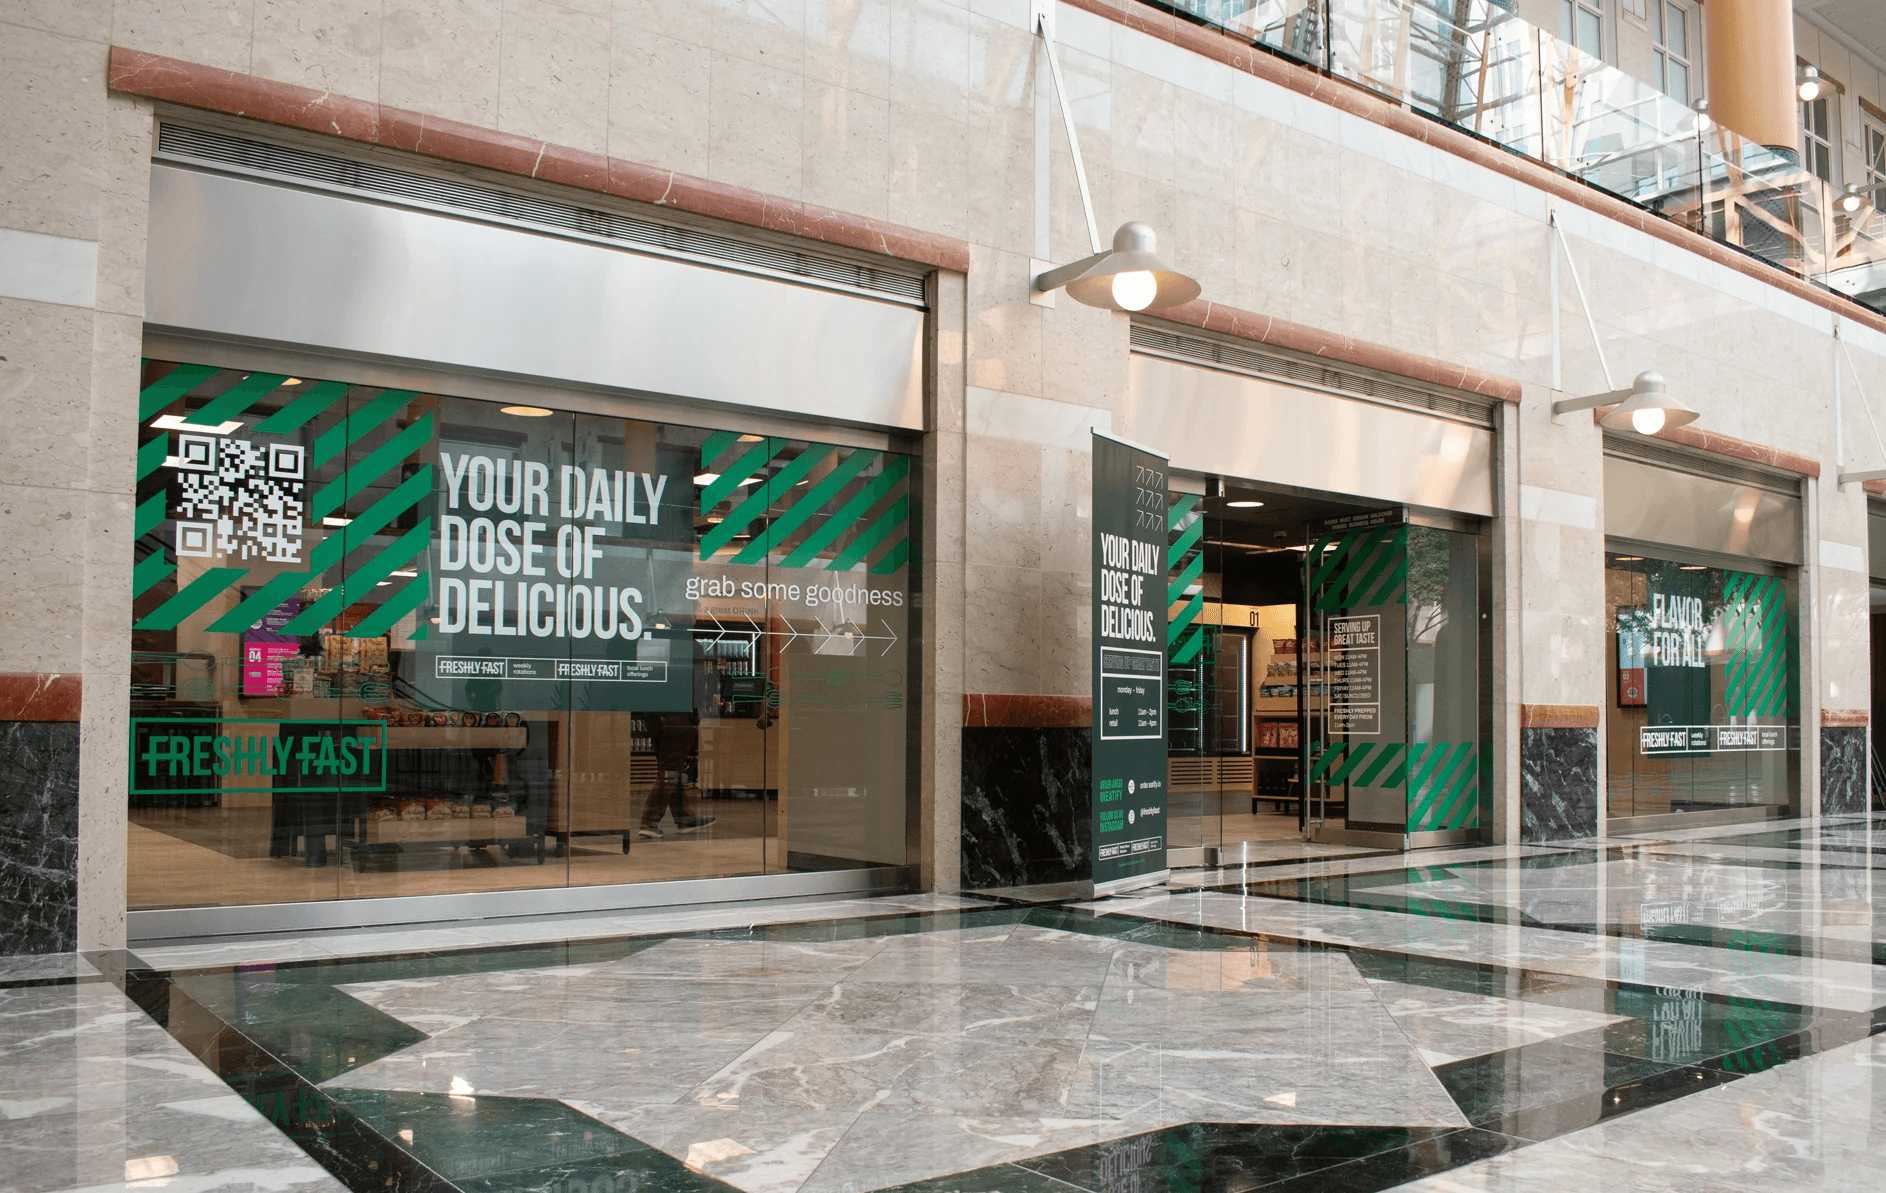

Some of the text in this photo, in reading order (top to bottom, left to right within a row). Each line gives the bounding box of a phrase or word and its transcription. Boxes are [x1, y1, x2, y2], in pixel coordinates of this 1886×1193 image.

[440, 452, 668, 525] YOUR DAILY
[440, 515, 606, 579] DOSE OF
[1100, 532, 1160, 575] YOUR DAILY
[685, 575, 903, 607] grab some goodness
[1101, 568, 1144, 606] DOSE OF
[439, 577, 652, 640] DELICIOUS.
[710, 606, 730, 615] great
[732, 607, 759, 615] DRINK
[1101, 604, 1156, 643] DELICIOUS.
[1250, 611, 1259, 627] 01
[1334, 620, 1370, 633] SERVING UP
[1653, 593, 1703, 630] FLAVOR
[248, 650, 261, 662] 04
[1334, 632, 1375, 645] GREAT TASTE
[1654, 631, 1705, 668] FOR ALL
